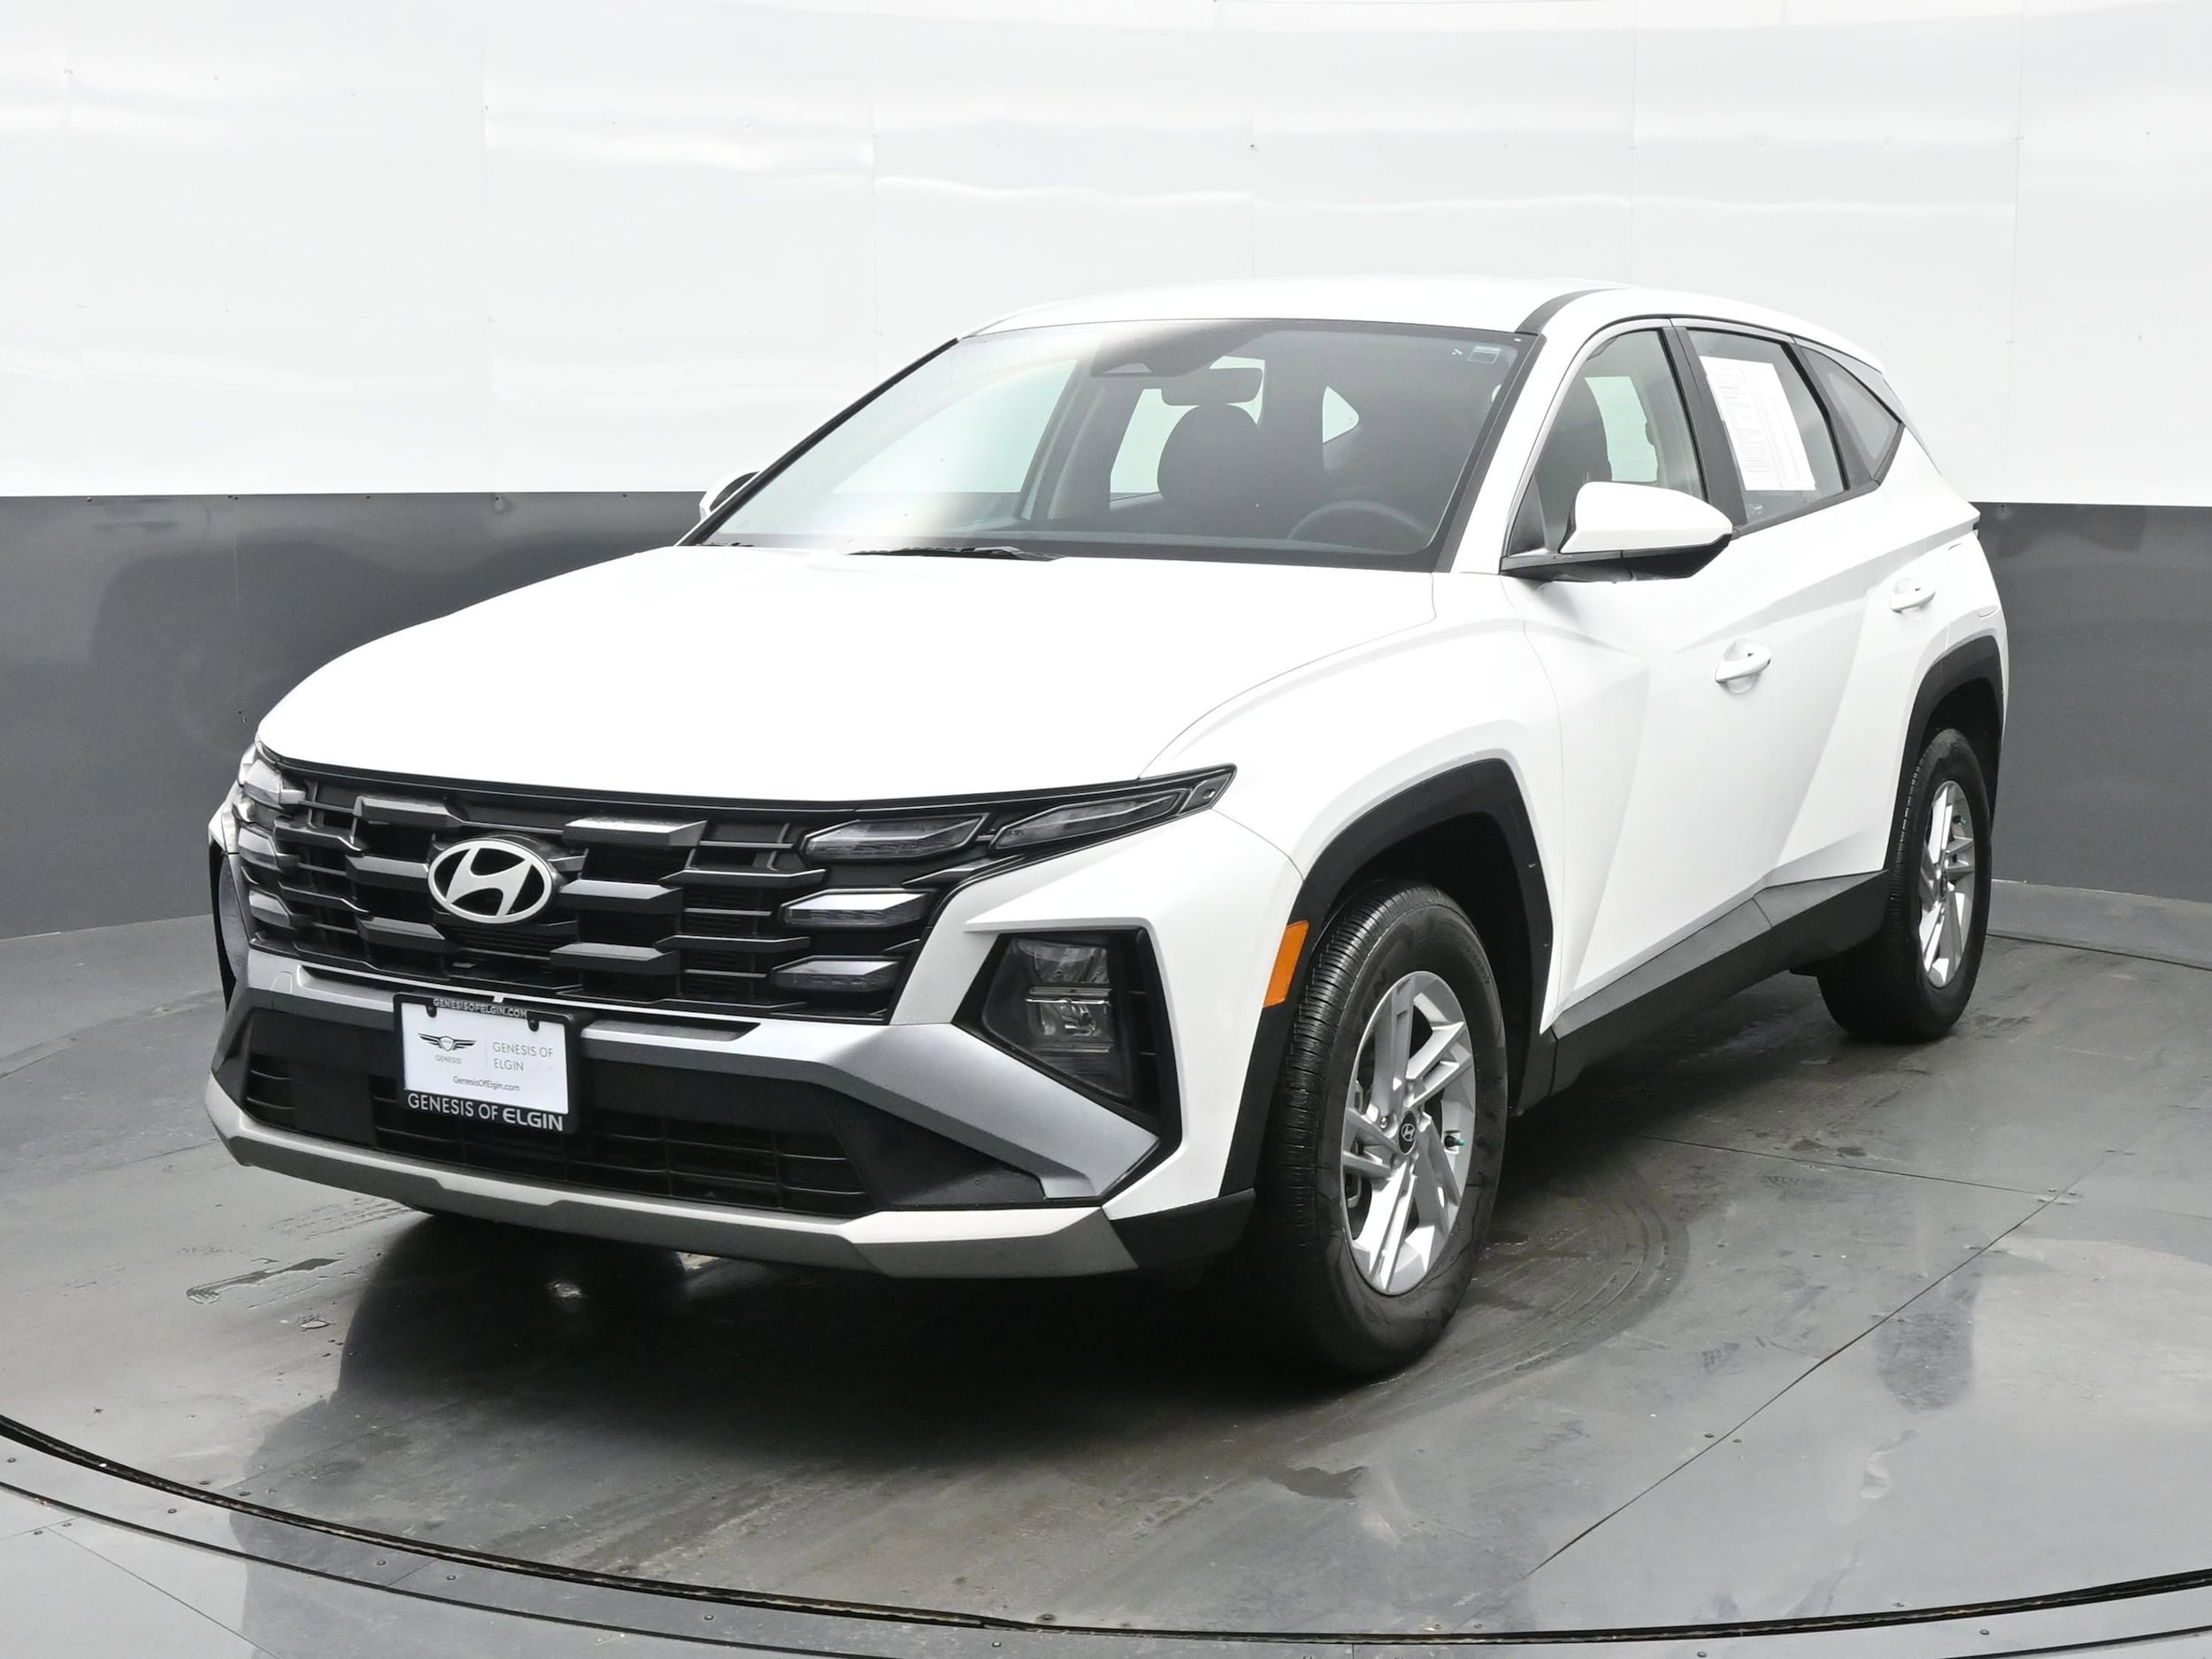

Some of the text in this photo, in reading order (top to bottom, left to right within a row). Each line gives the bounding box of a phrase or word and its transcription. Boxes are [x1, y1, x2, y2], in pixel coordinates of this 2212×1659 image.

[433, 998, 527, 1018] GENESISOFELGIN.COM
[493, 1041, 554, 1057] GENESIS OF
[494, 1058, 524, 1071] ELGIN
[452, 1075, 520, 1092] GenesisOfElgin.com
[407, 1093, 564, 1132] GENESIS OF ELGIN
